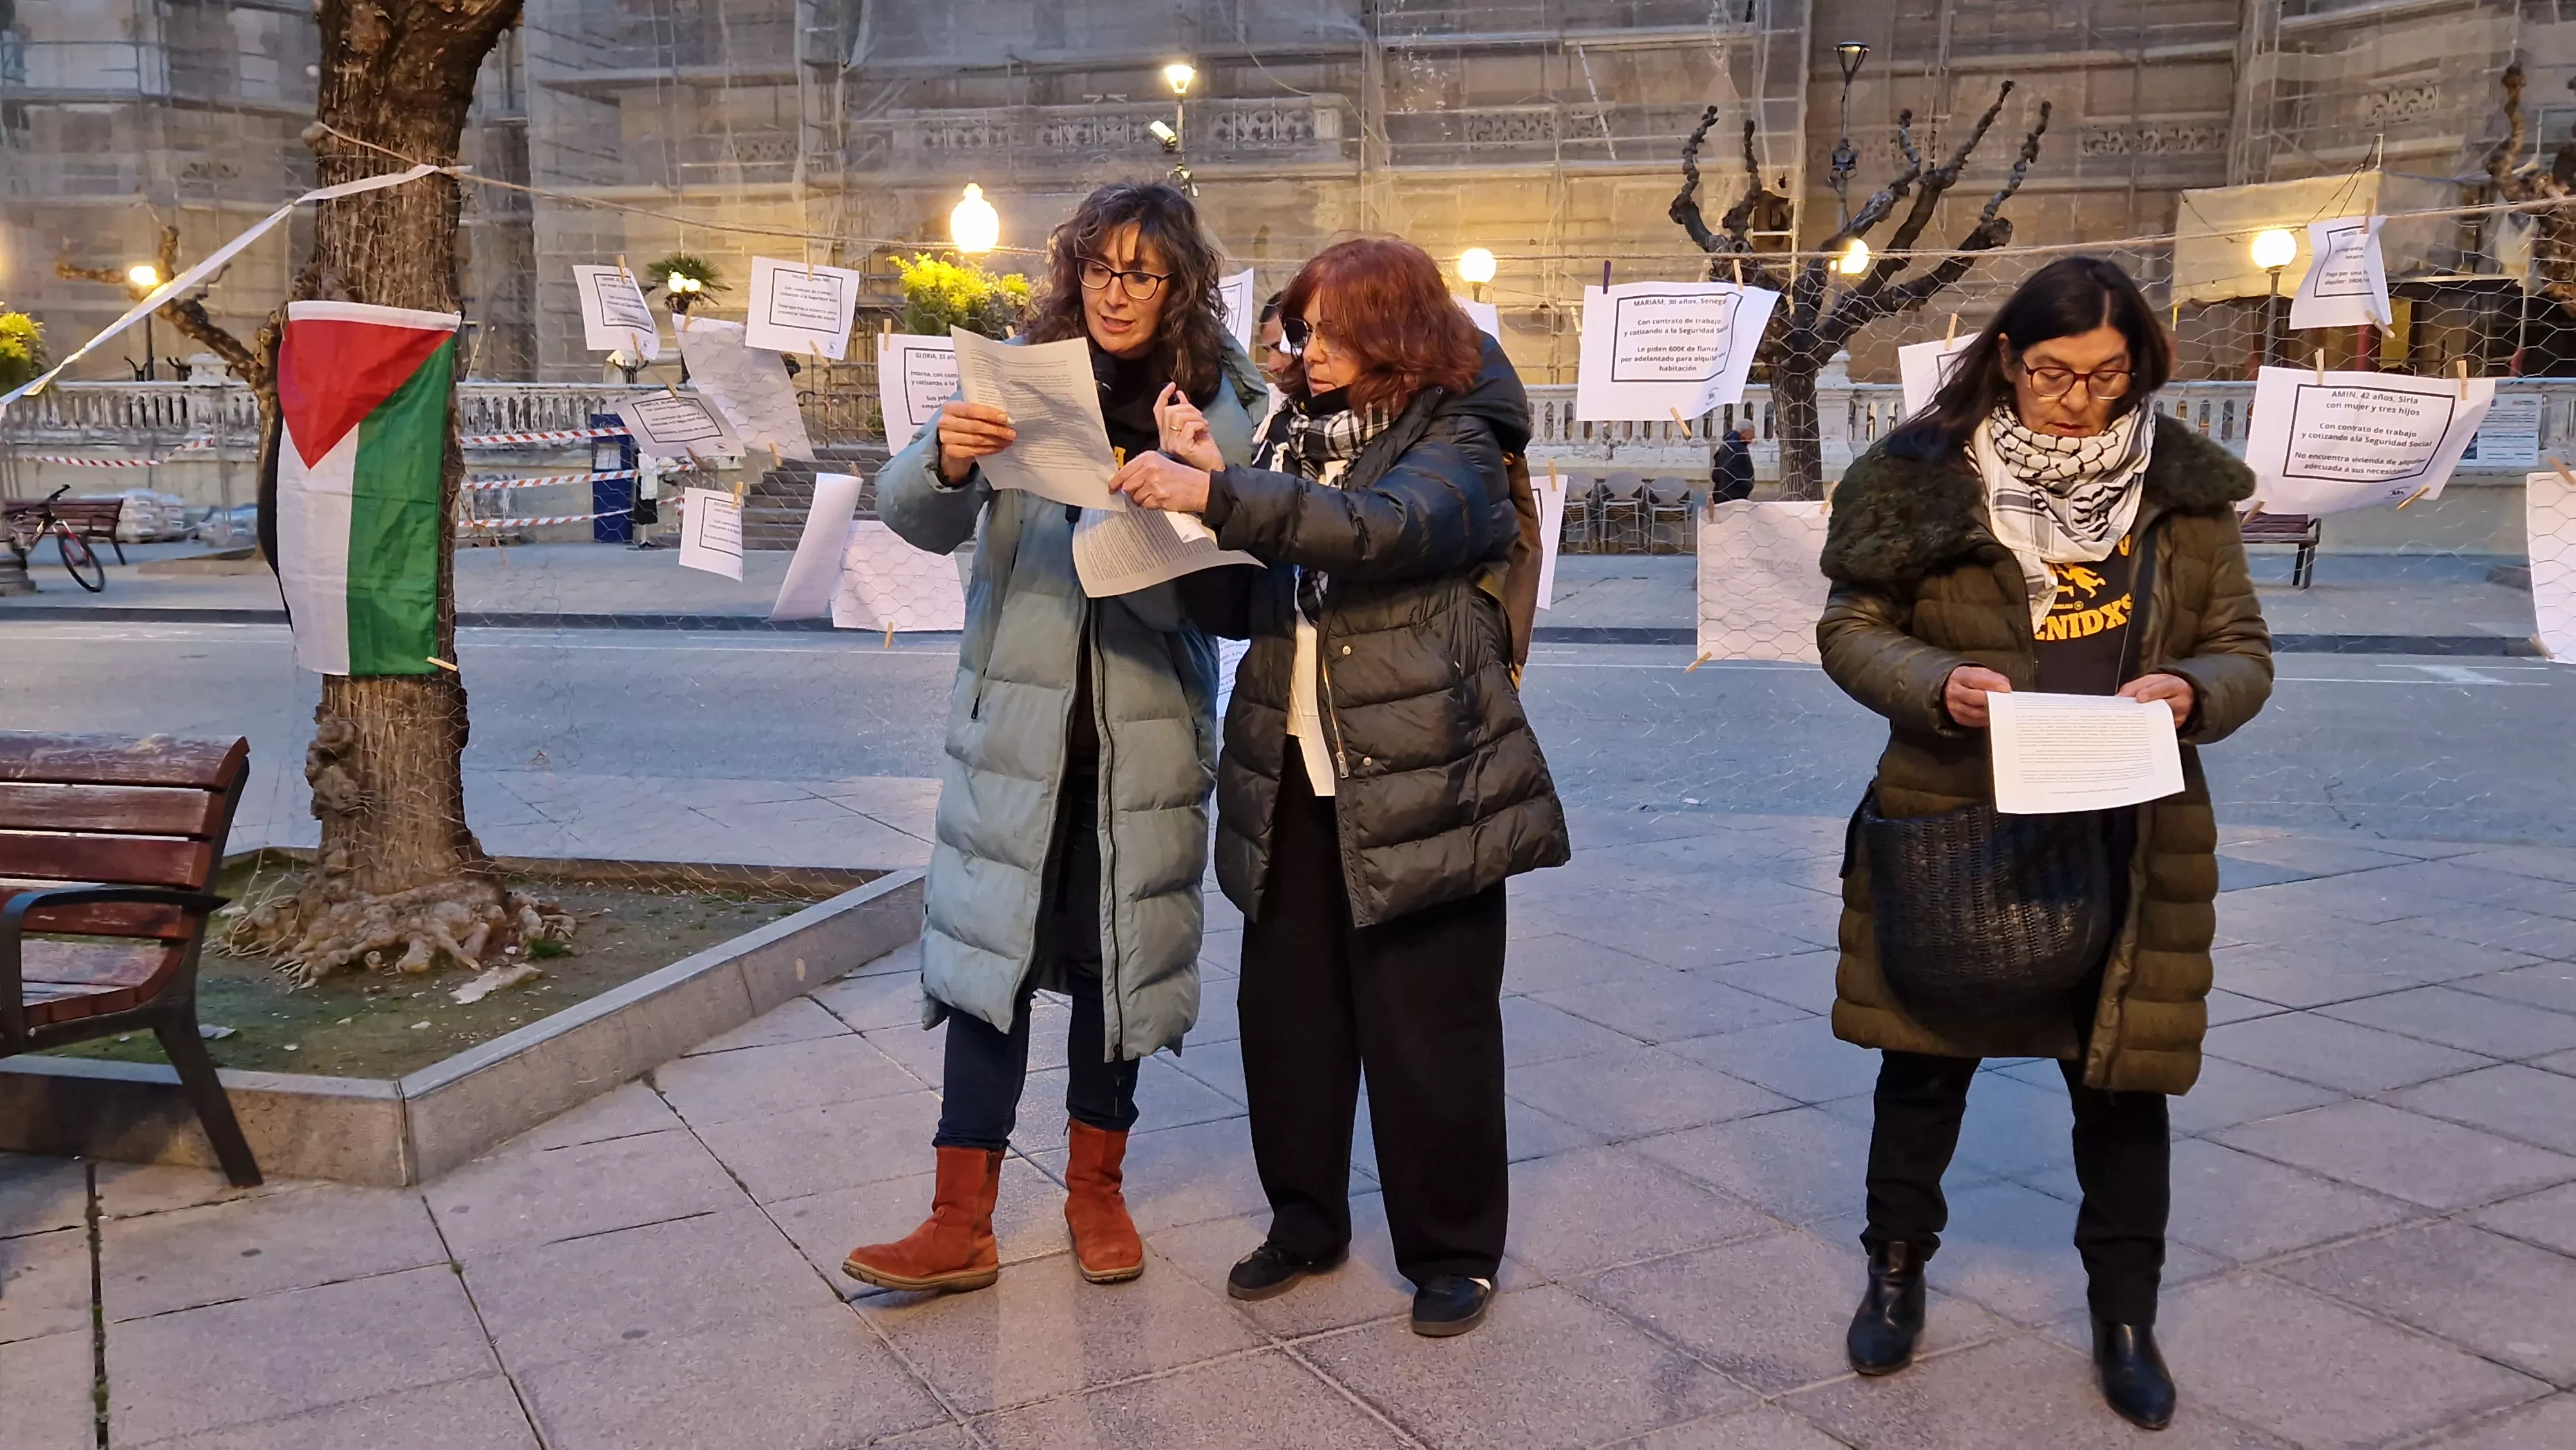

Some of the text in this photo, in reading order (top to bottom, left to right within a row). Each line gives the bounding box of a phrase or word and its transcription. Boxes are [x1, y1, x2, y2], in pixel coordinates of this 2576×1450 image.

[1701, 297, 1727, 306] Senega
[1679, 326, 1714, 335] Seguridad
[2331, 390, 2358, 399] AMIN,
[2372, 393, 2396, 403] años,
[2398, 396, 2418, 405] Siria
[2344, 402, 2369, 411] mujer
[2379, 406, 2396, 414] tres
[2398, 407, 2420, 417] hijos
[2338, 424, 2371, 433] contrato
[2385, 428, 2417, 438] trabajo
[2308, 431, 2348, 441] cotizando
[2365, 436, 2407, 447] Seguridad
[2308, 453, 2349, 462] encuentra
[2352, 456, 2383, 464] vivienda
[2304, 462, 2342, 472] adecuada
